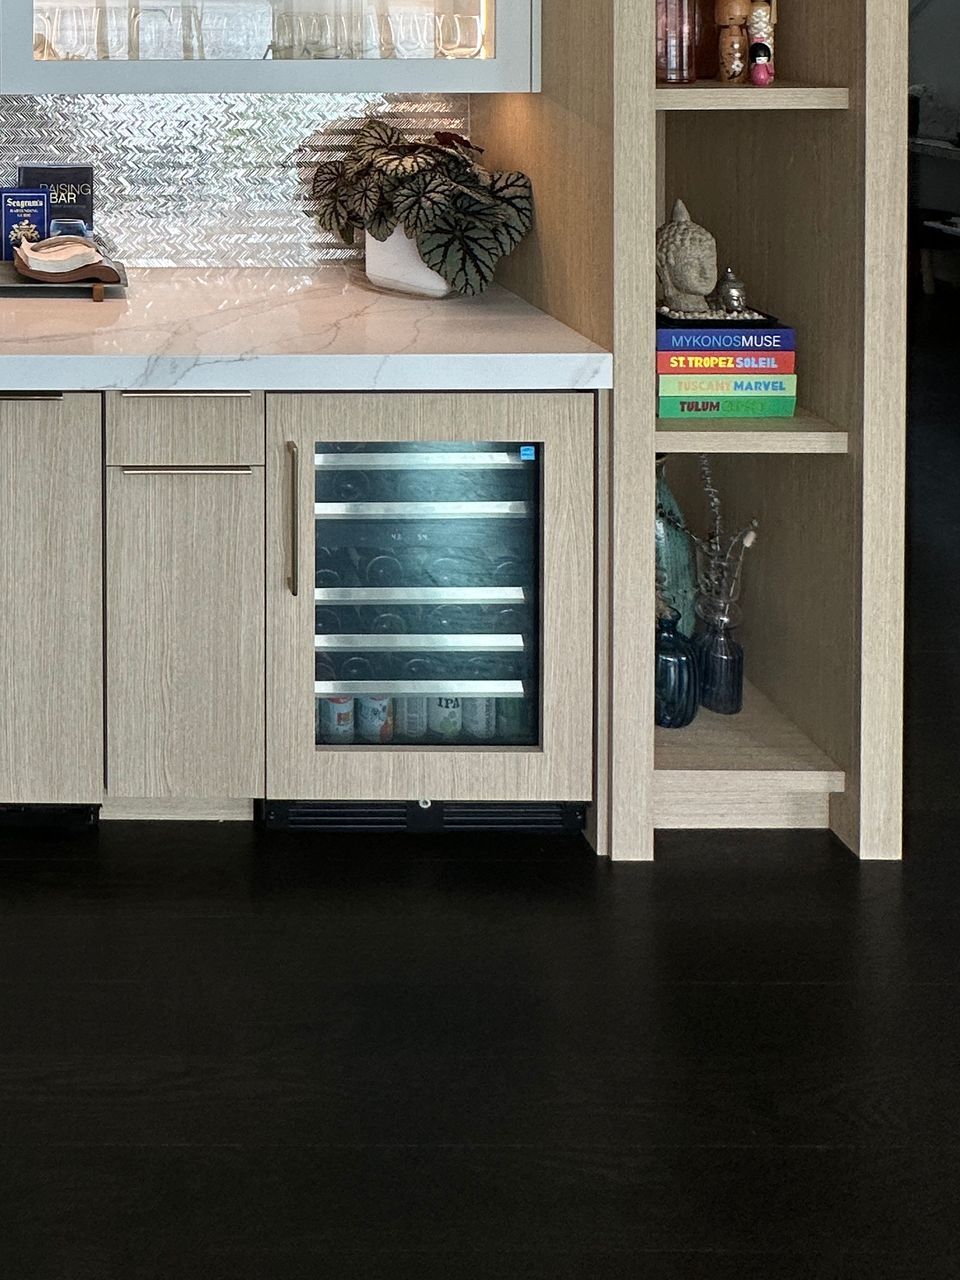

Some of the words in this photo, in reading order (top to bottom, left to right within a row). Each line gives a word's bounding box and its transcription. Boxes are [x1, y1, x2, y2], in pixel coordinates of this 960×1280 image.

[6, 197, 44, 208] Seagram's
[50, 192, 77, 204] BAR
[670, 357, 686, 368] ST.
[687, 356, 735, 368] TROPEZ
[735, 357, 778, 368] SOLEIL
[678, 381, 730, 392] TUSCANY
[733, 380, 786, 391] MARVEL
[679, 401, 720, 412] TULUM
[437, 697, 460, 709] IPA
